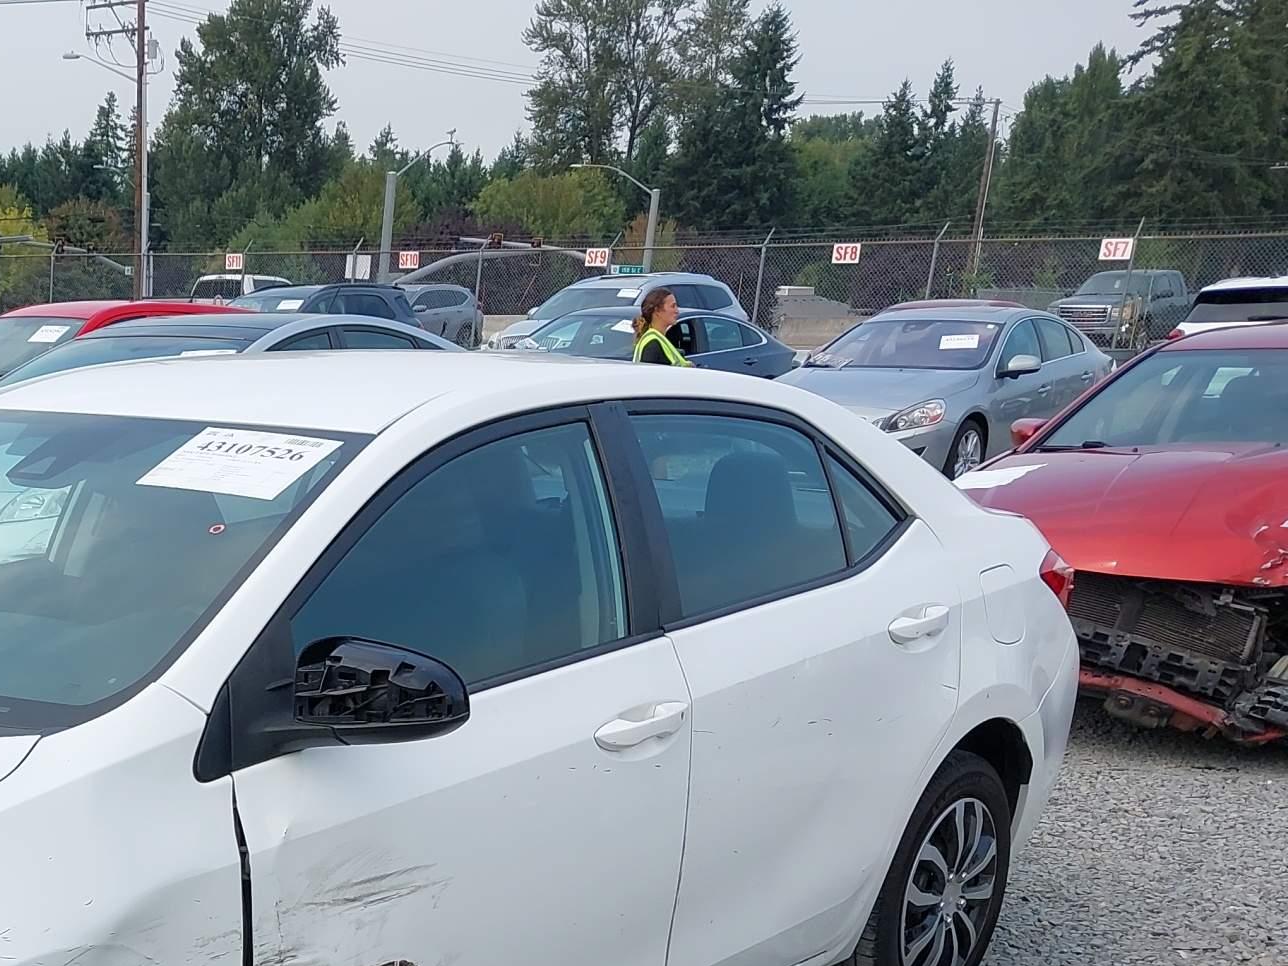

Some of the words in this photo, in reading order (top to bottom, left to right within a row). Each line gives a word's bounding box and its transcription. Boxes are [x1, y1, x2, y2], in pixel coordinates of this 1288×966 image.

[587, 250, 607, 264] SF9
[835, 245, 858, 261] SF8
[1103, 241, 1129, 258] SF7
[227, 255, 241, 268] SF11
[400, 253, 418, 266] SF10
[197, 440, 304, 462] 43107526
